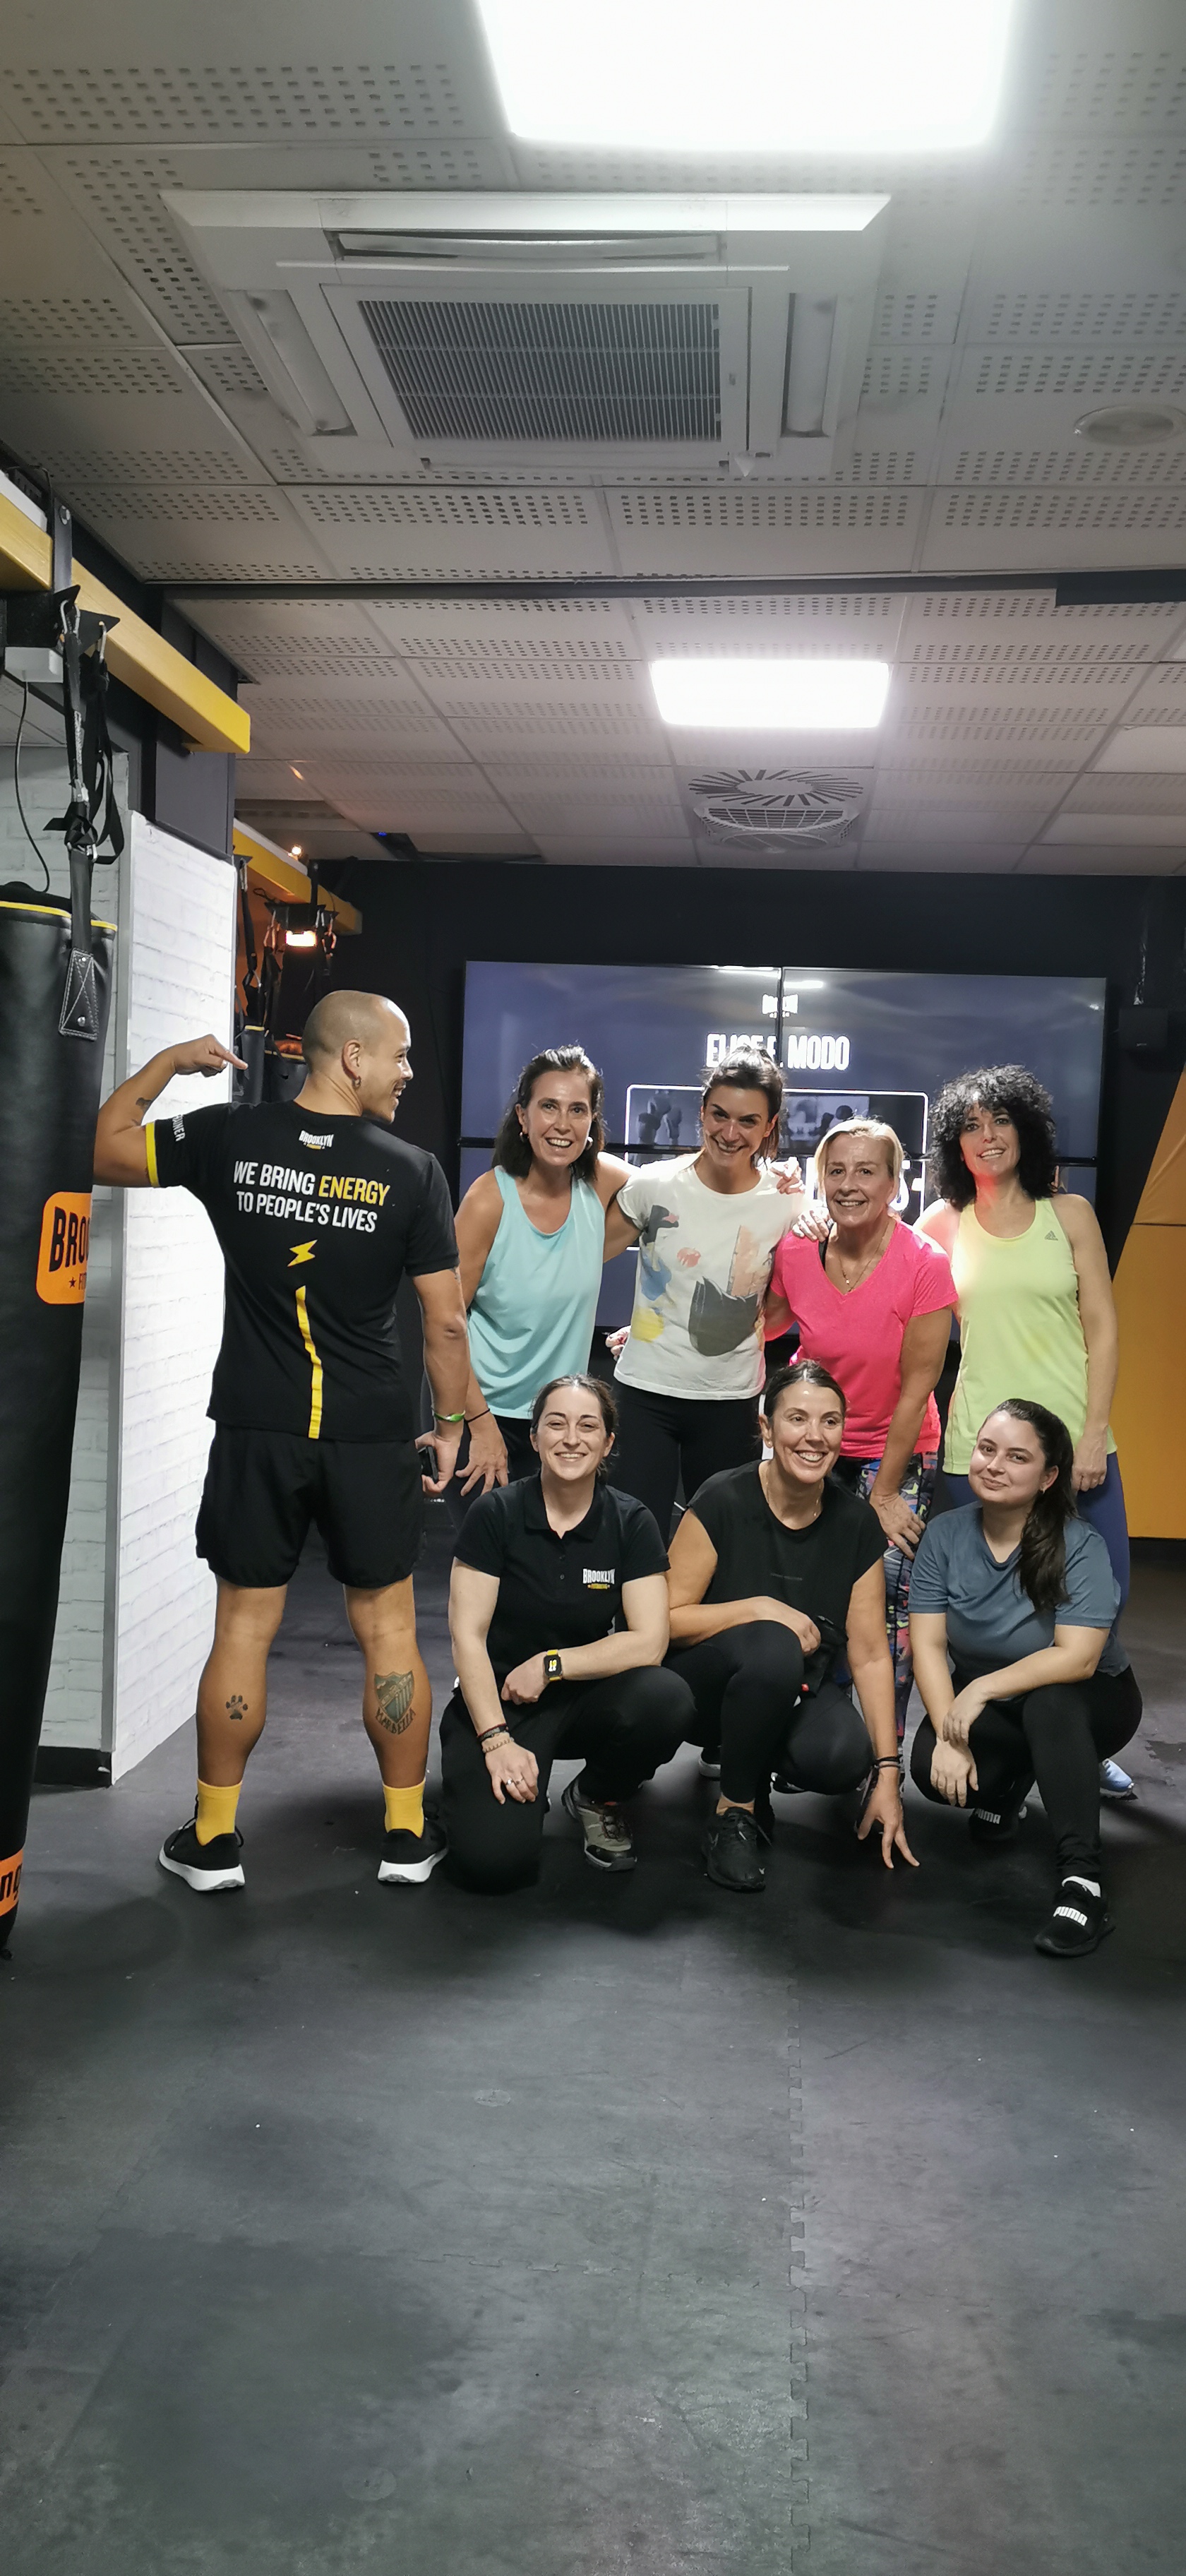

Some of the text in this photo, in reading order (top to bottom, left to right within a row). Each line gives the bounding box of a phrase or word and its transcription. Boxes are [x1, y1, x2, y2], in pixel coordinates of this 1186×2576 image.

[787, 1034, 851, 1071] MODO
[299, 1130, 334, 1147] BROOKLYN
[234, 1161, 390, 1206] WE BRING ENERGY
[236, 1191, 378, 1233] TO PEOPLE'S LIVES
[582, 1568, 616, 1585] BROOKLYN
[1053, 1906, 1088, 1926] PUMA
